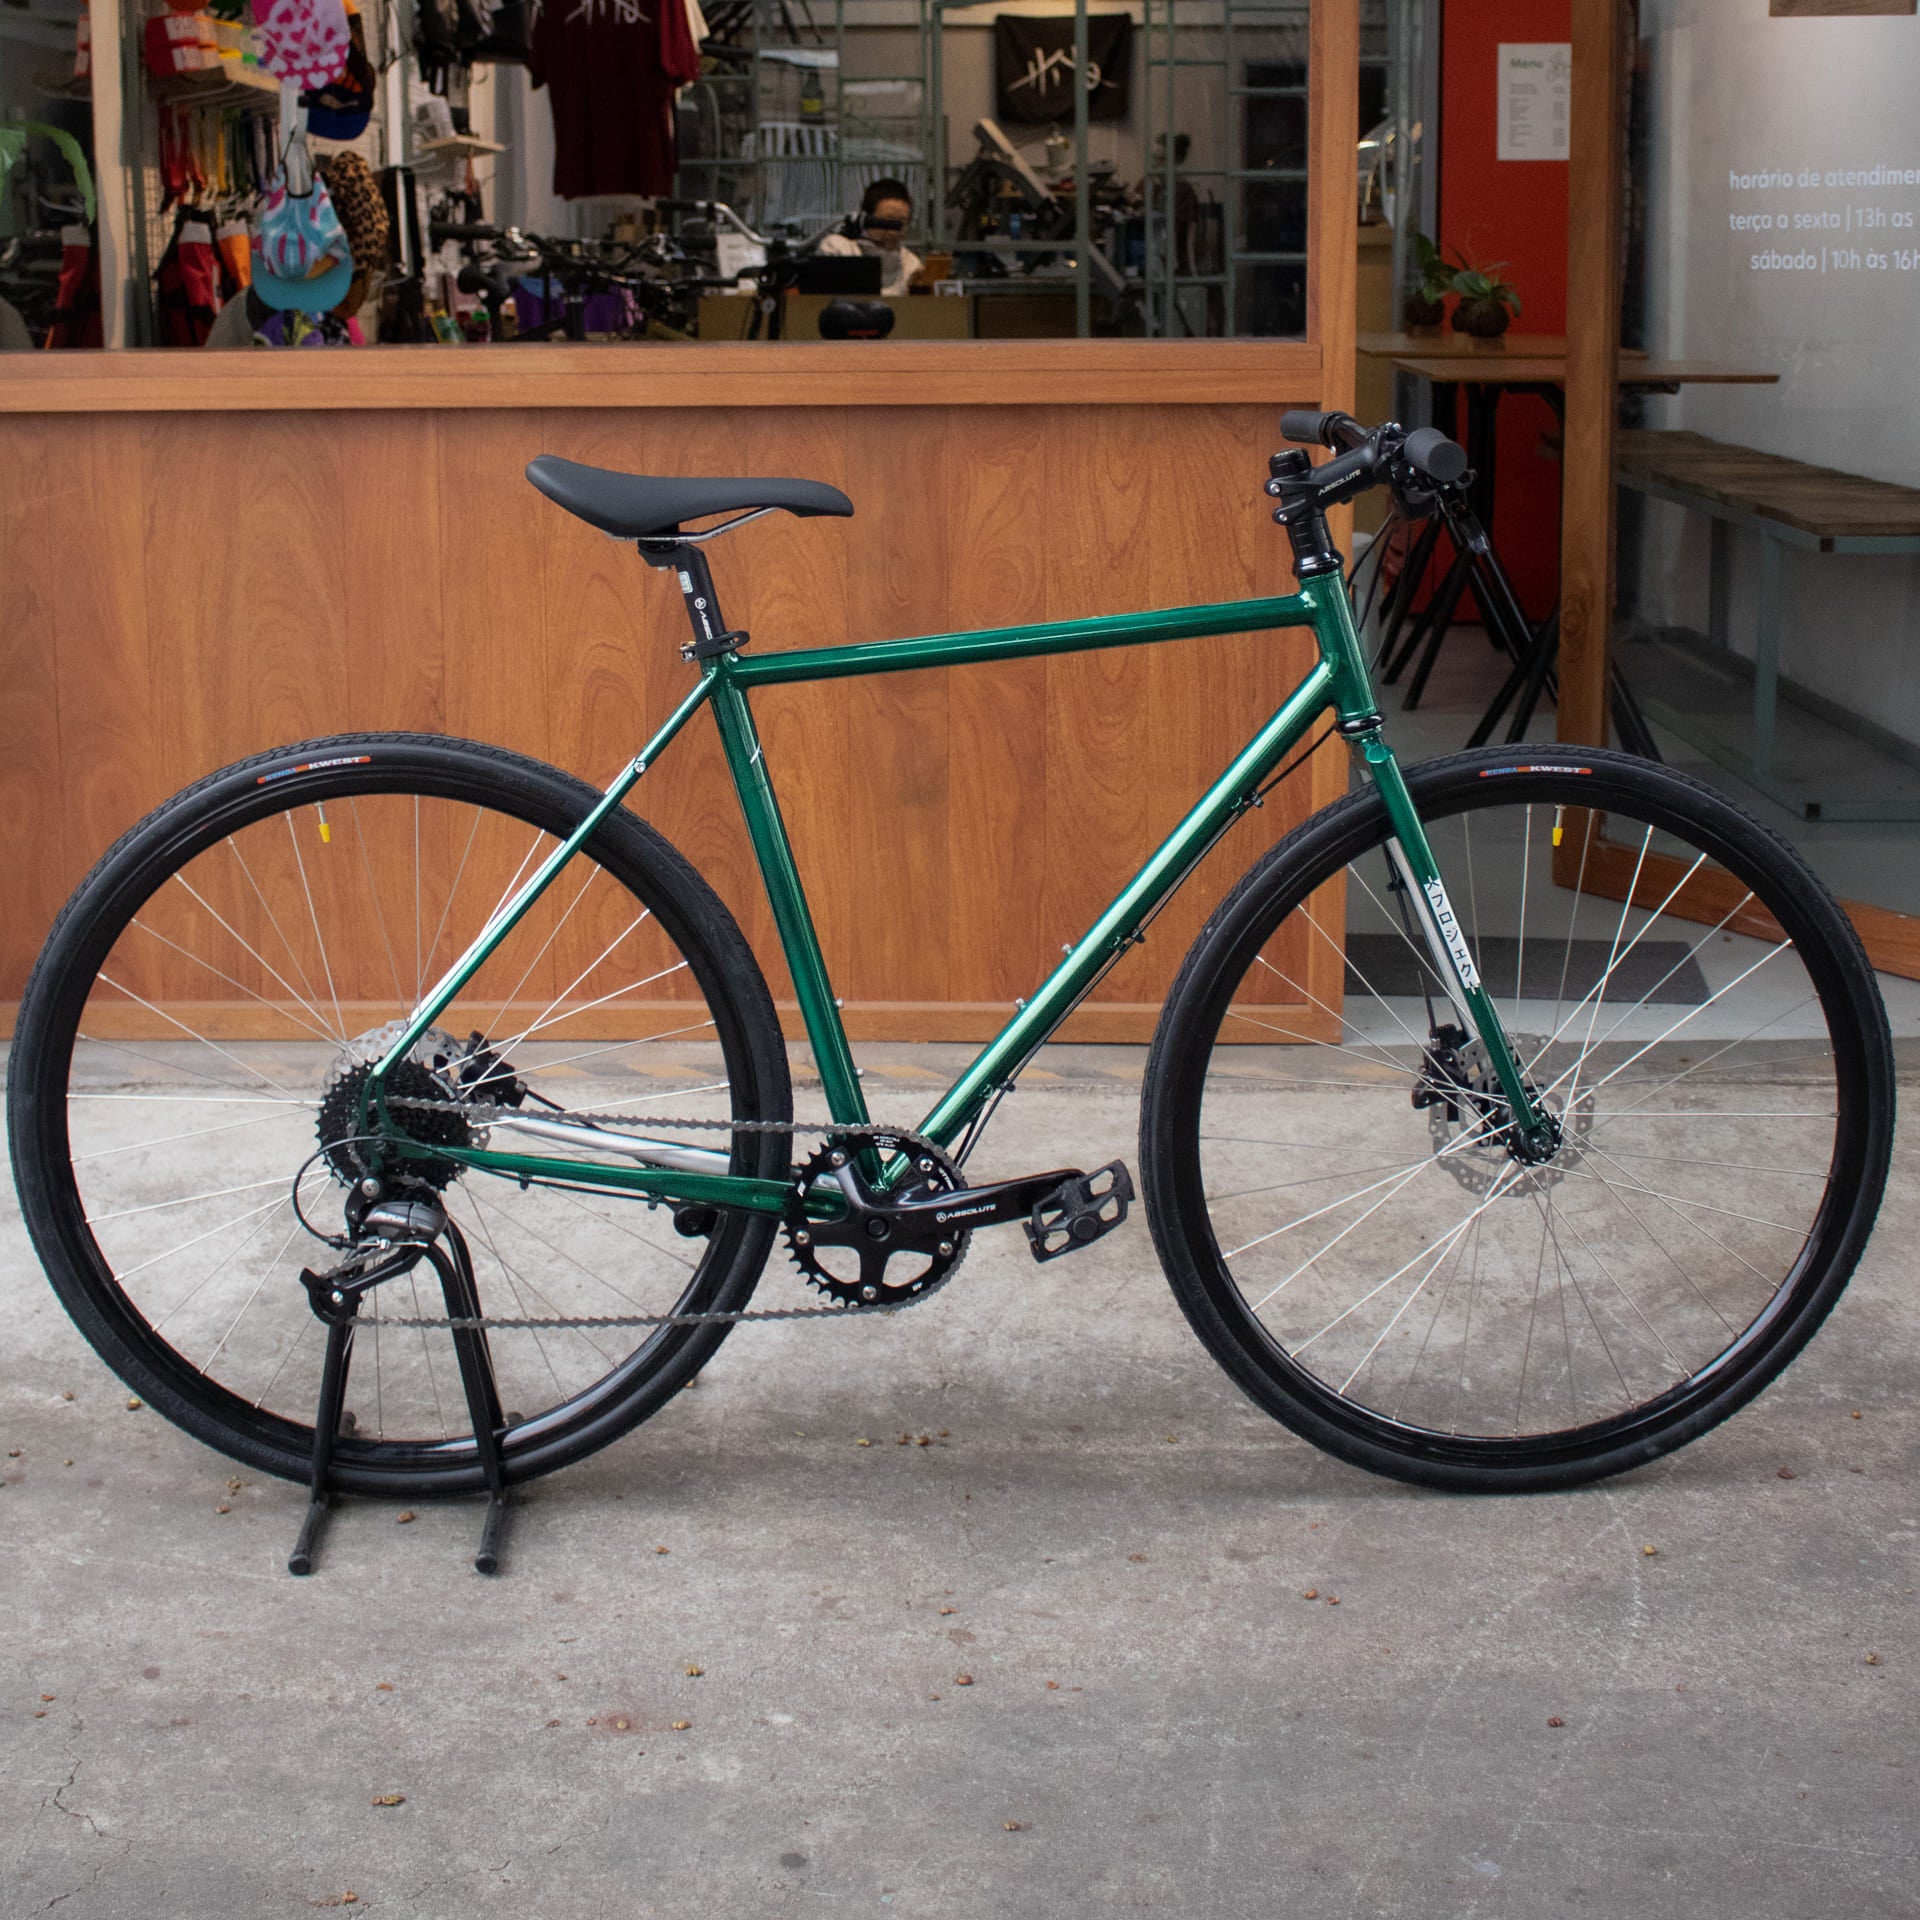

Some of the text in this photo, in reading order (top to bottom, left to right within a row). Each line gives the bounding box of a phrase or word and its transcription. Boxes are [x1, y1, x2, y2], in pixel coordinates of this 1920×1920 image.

[1730, 168, 1793, 190] horário
[1798, 167, 1820, 188] de
[1729, 213, 1772, 232] terça
[1777, 214, 1788, 229] a
[1794, 211, 1841, 229] sexta
[1855, 207, 1886, 228] 13h
[1751, 248, 1817, 270] sábado
[1833, 249, 1861, 270] 10h
[1318, 469, 1361, 496] ABSOLUTE
[308, 756, 361, 770] KWEST
[1530, 765, 1580, 774] KWEST
[947, 1203, 997, 1220] ABSOLUTE
